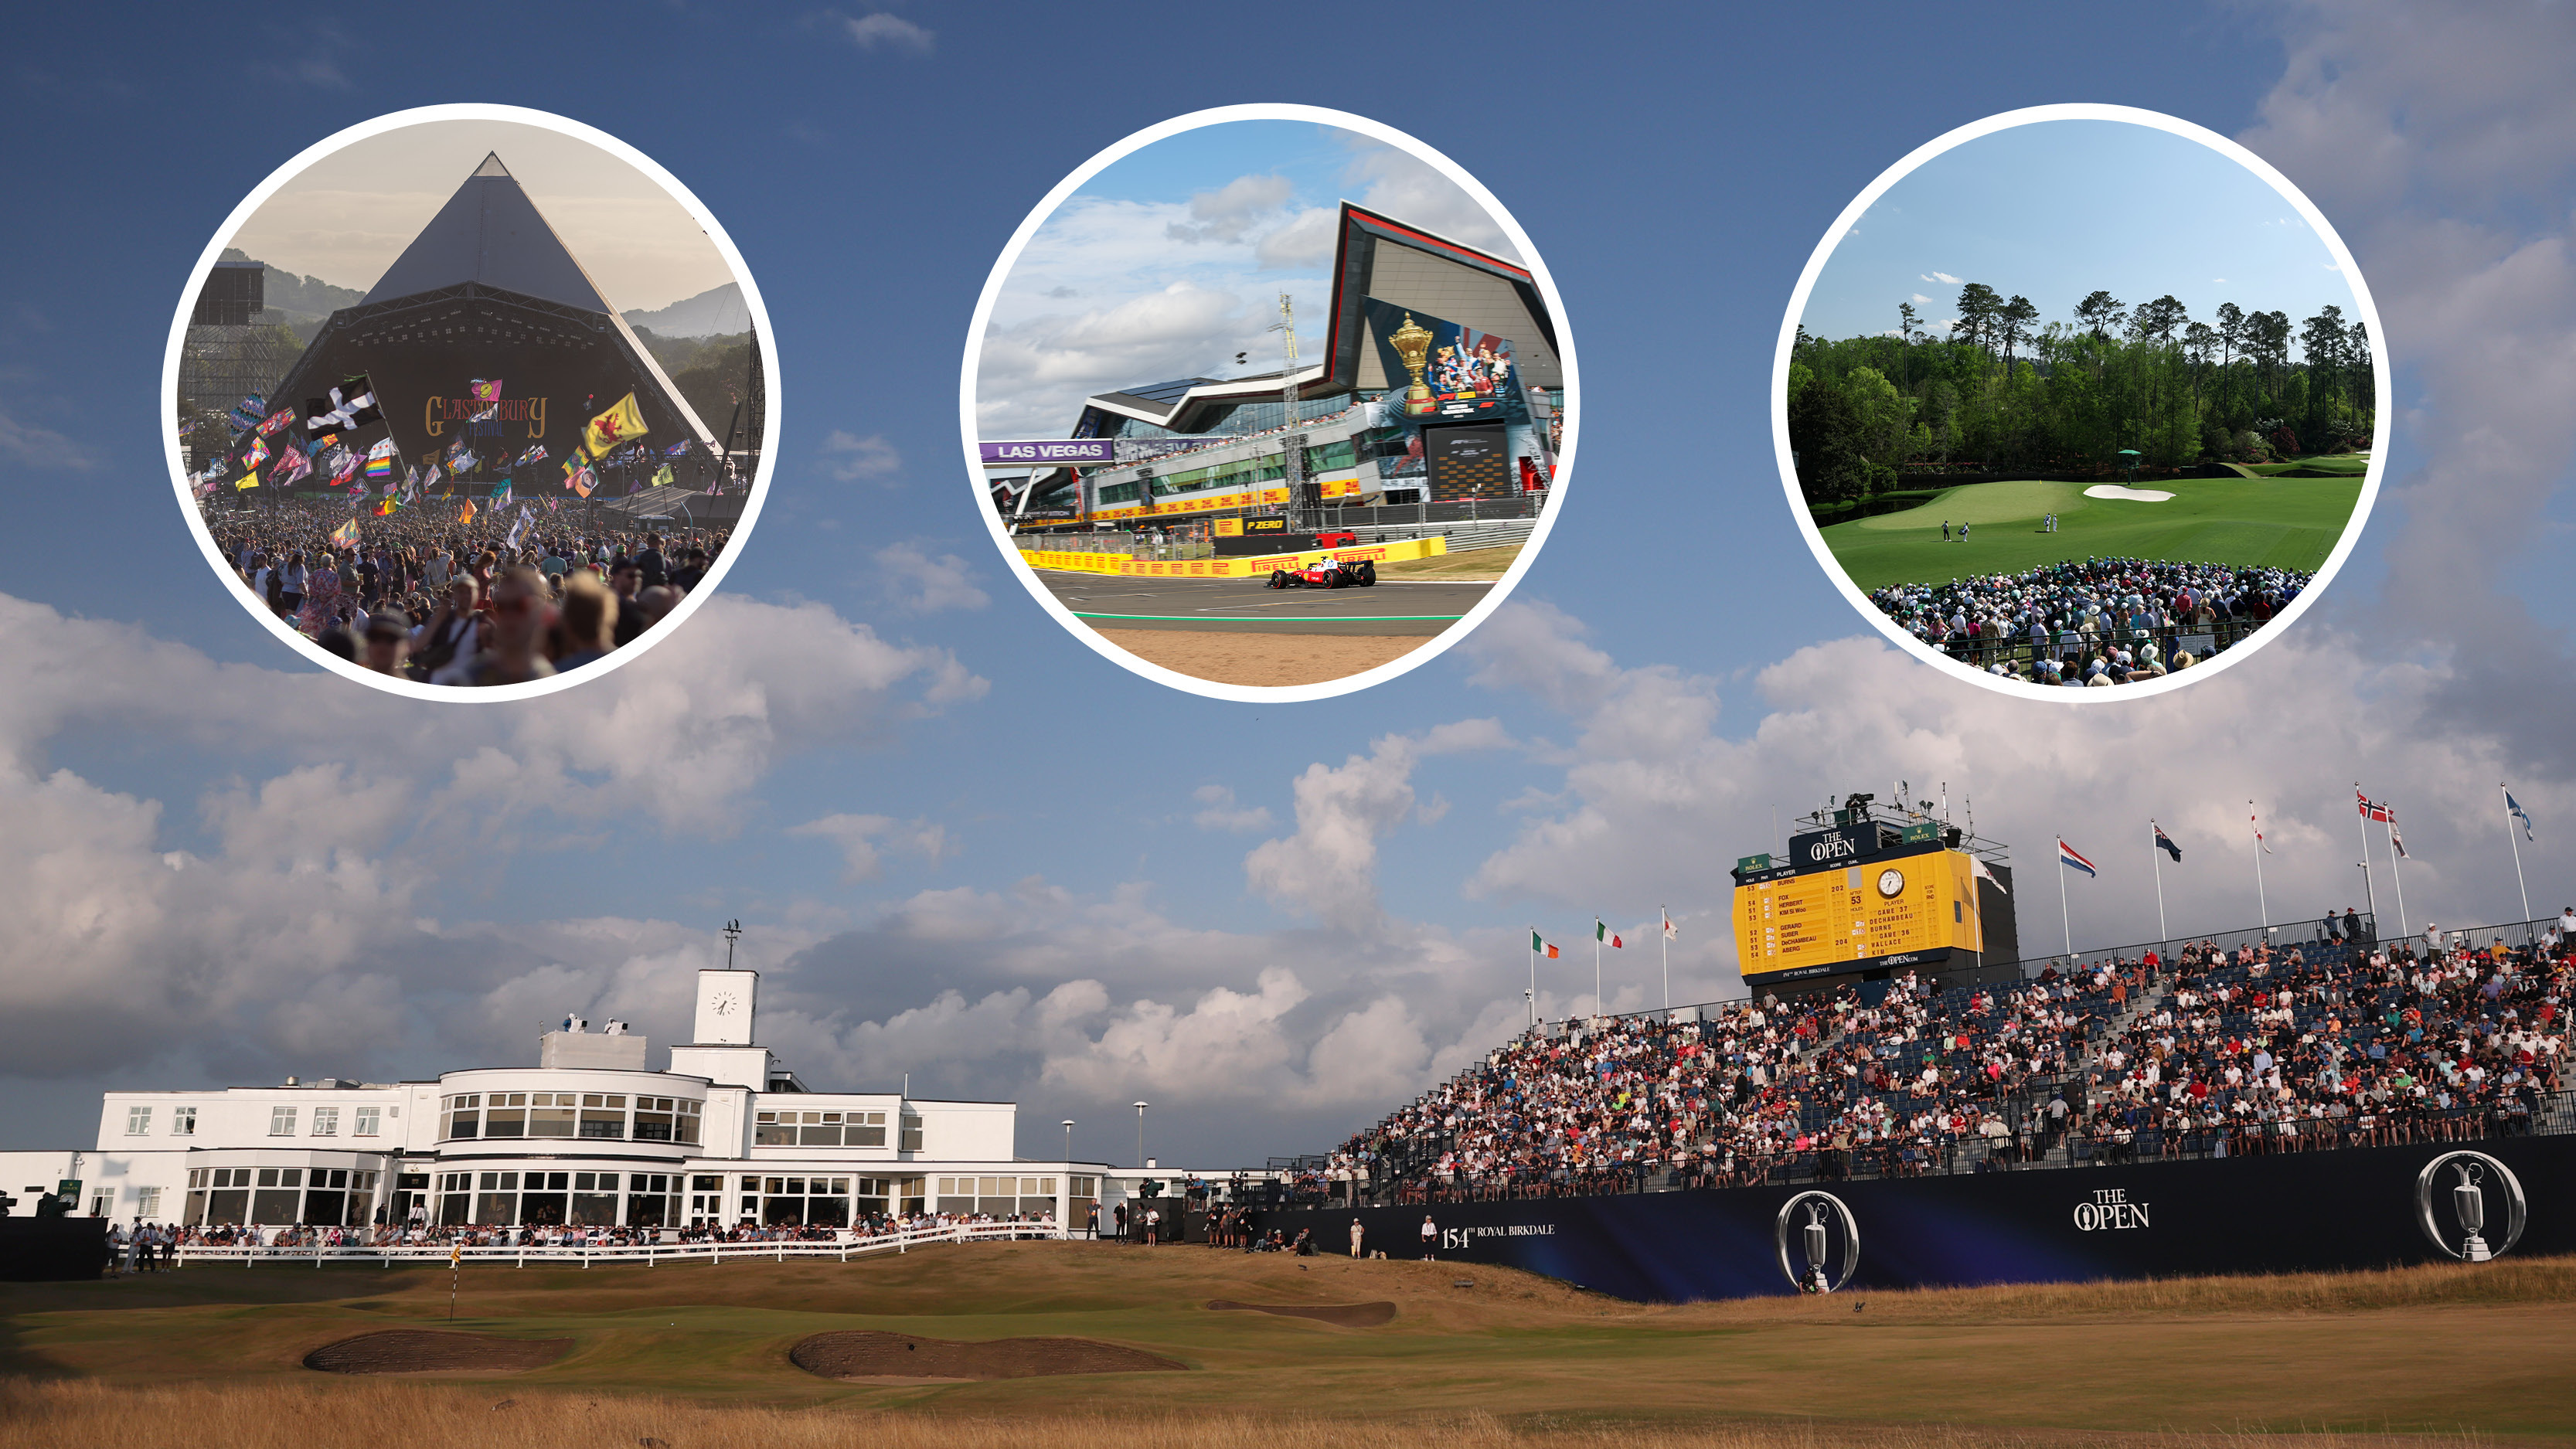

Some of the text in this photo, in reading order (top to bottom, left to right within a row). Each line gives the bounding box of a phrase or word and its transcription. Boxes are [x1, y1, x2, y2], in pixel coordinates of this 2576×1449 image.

[426, 396, 548, 439] GLASTOBURY
[999, 446, 1036, 457] LAS
[1038, 444, 1103, 457] VEGAS
[1247, 519, 1284, 530] P ZERO
[1251, 556, 1299, 573] PIRELLI
[1822, 831, 1842, 842] THE
[1810, 838, 1856, 861] OPEN
[1779, 900, 1802, 908] HERBERT
[1851, 896, 1861, 904] 53
[1870, 913, 1913, 924] DECHAMBEAU
[1871, 939, 1901, 948] WALLACE
[2093, 1189, 2126, 1204] THE
[2074, 1202, 2149, 1231] OPEN
[1477, 1226, 1506, 1236] ROYAL
[1509, 1224, 1555, 1236] BIRKDALE
